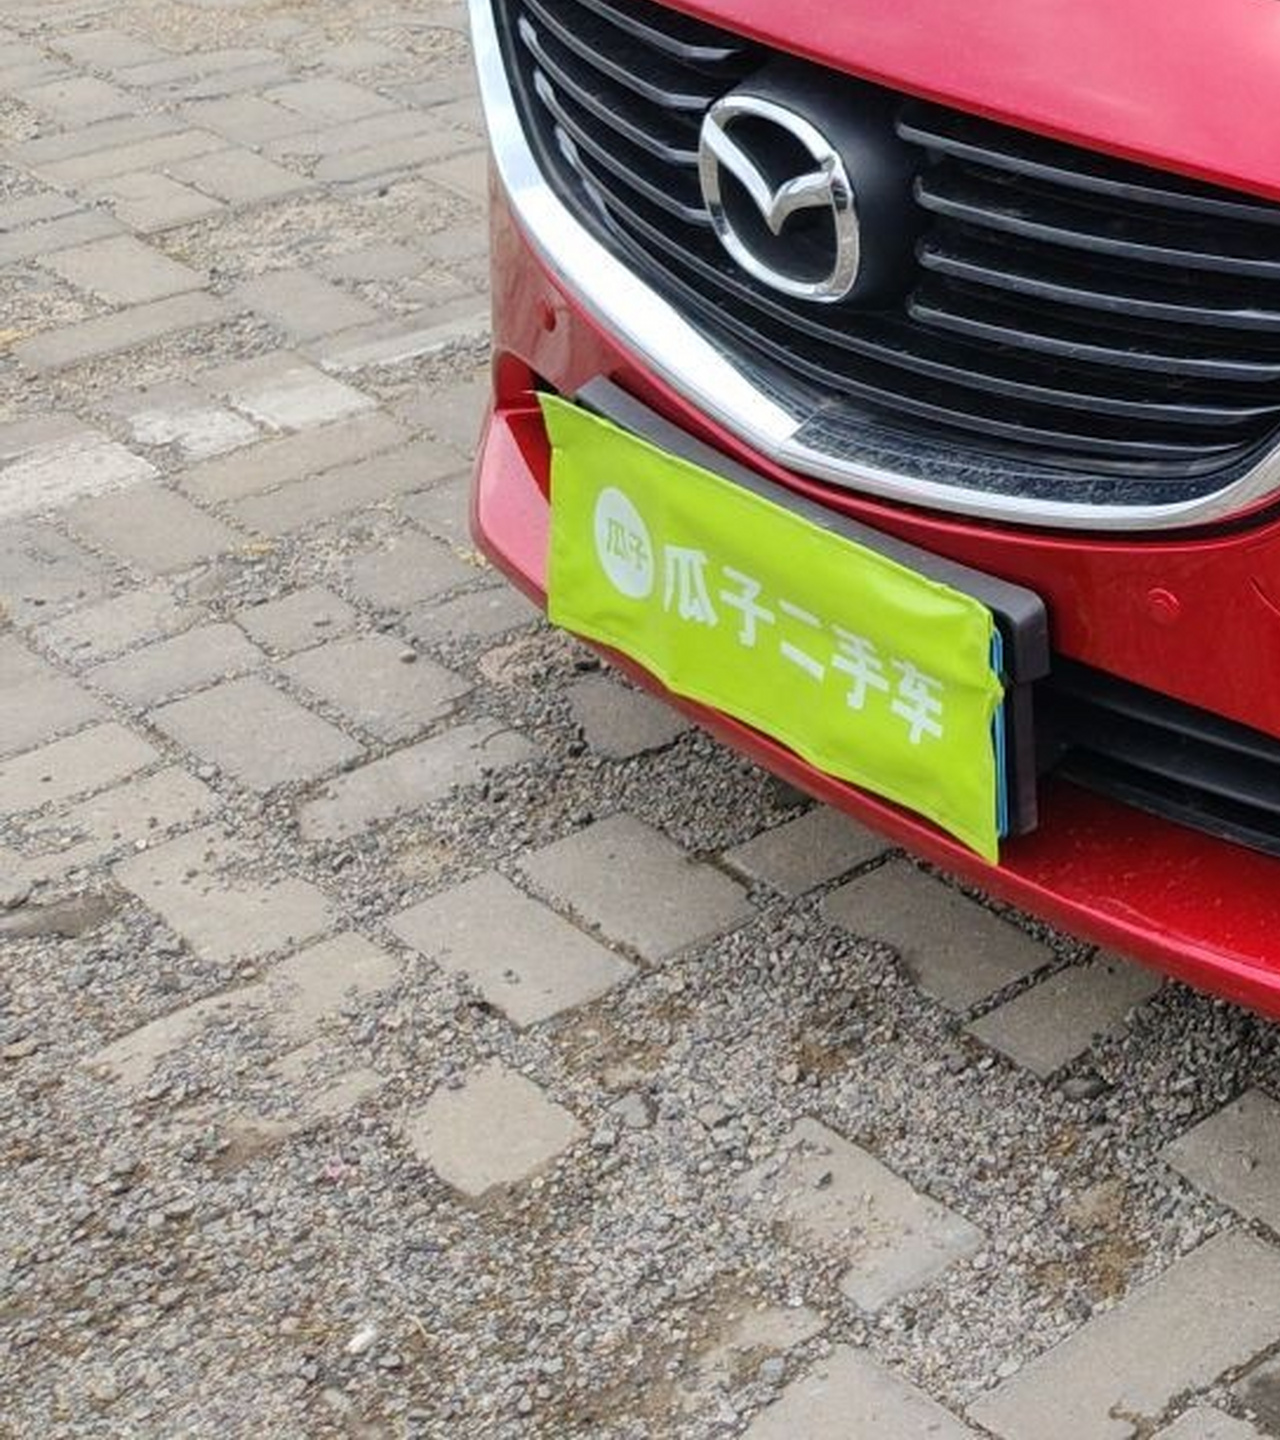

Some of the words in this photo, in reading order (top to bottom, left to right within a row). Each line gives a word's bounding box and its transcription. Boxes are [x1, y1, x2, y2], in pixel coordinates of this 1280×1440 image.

[605, 515, 650, 572] 瓜子
[662, 543, 943, 745] 瓜子二手车
